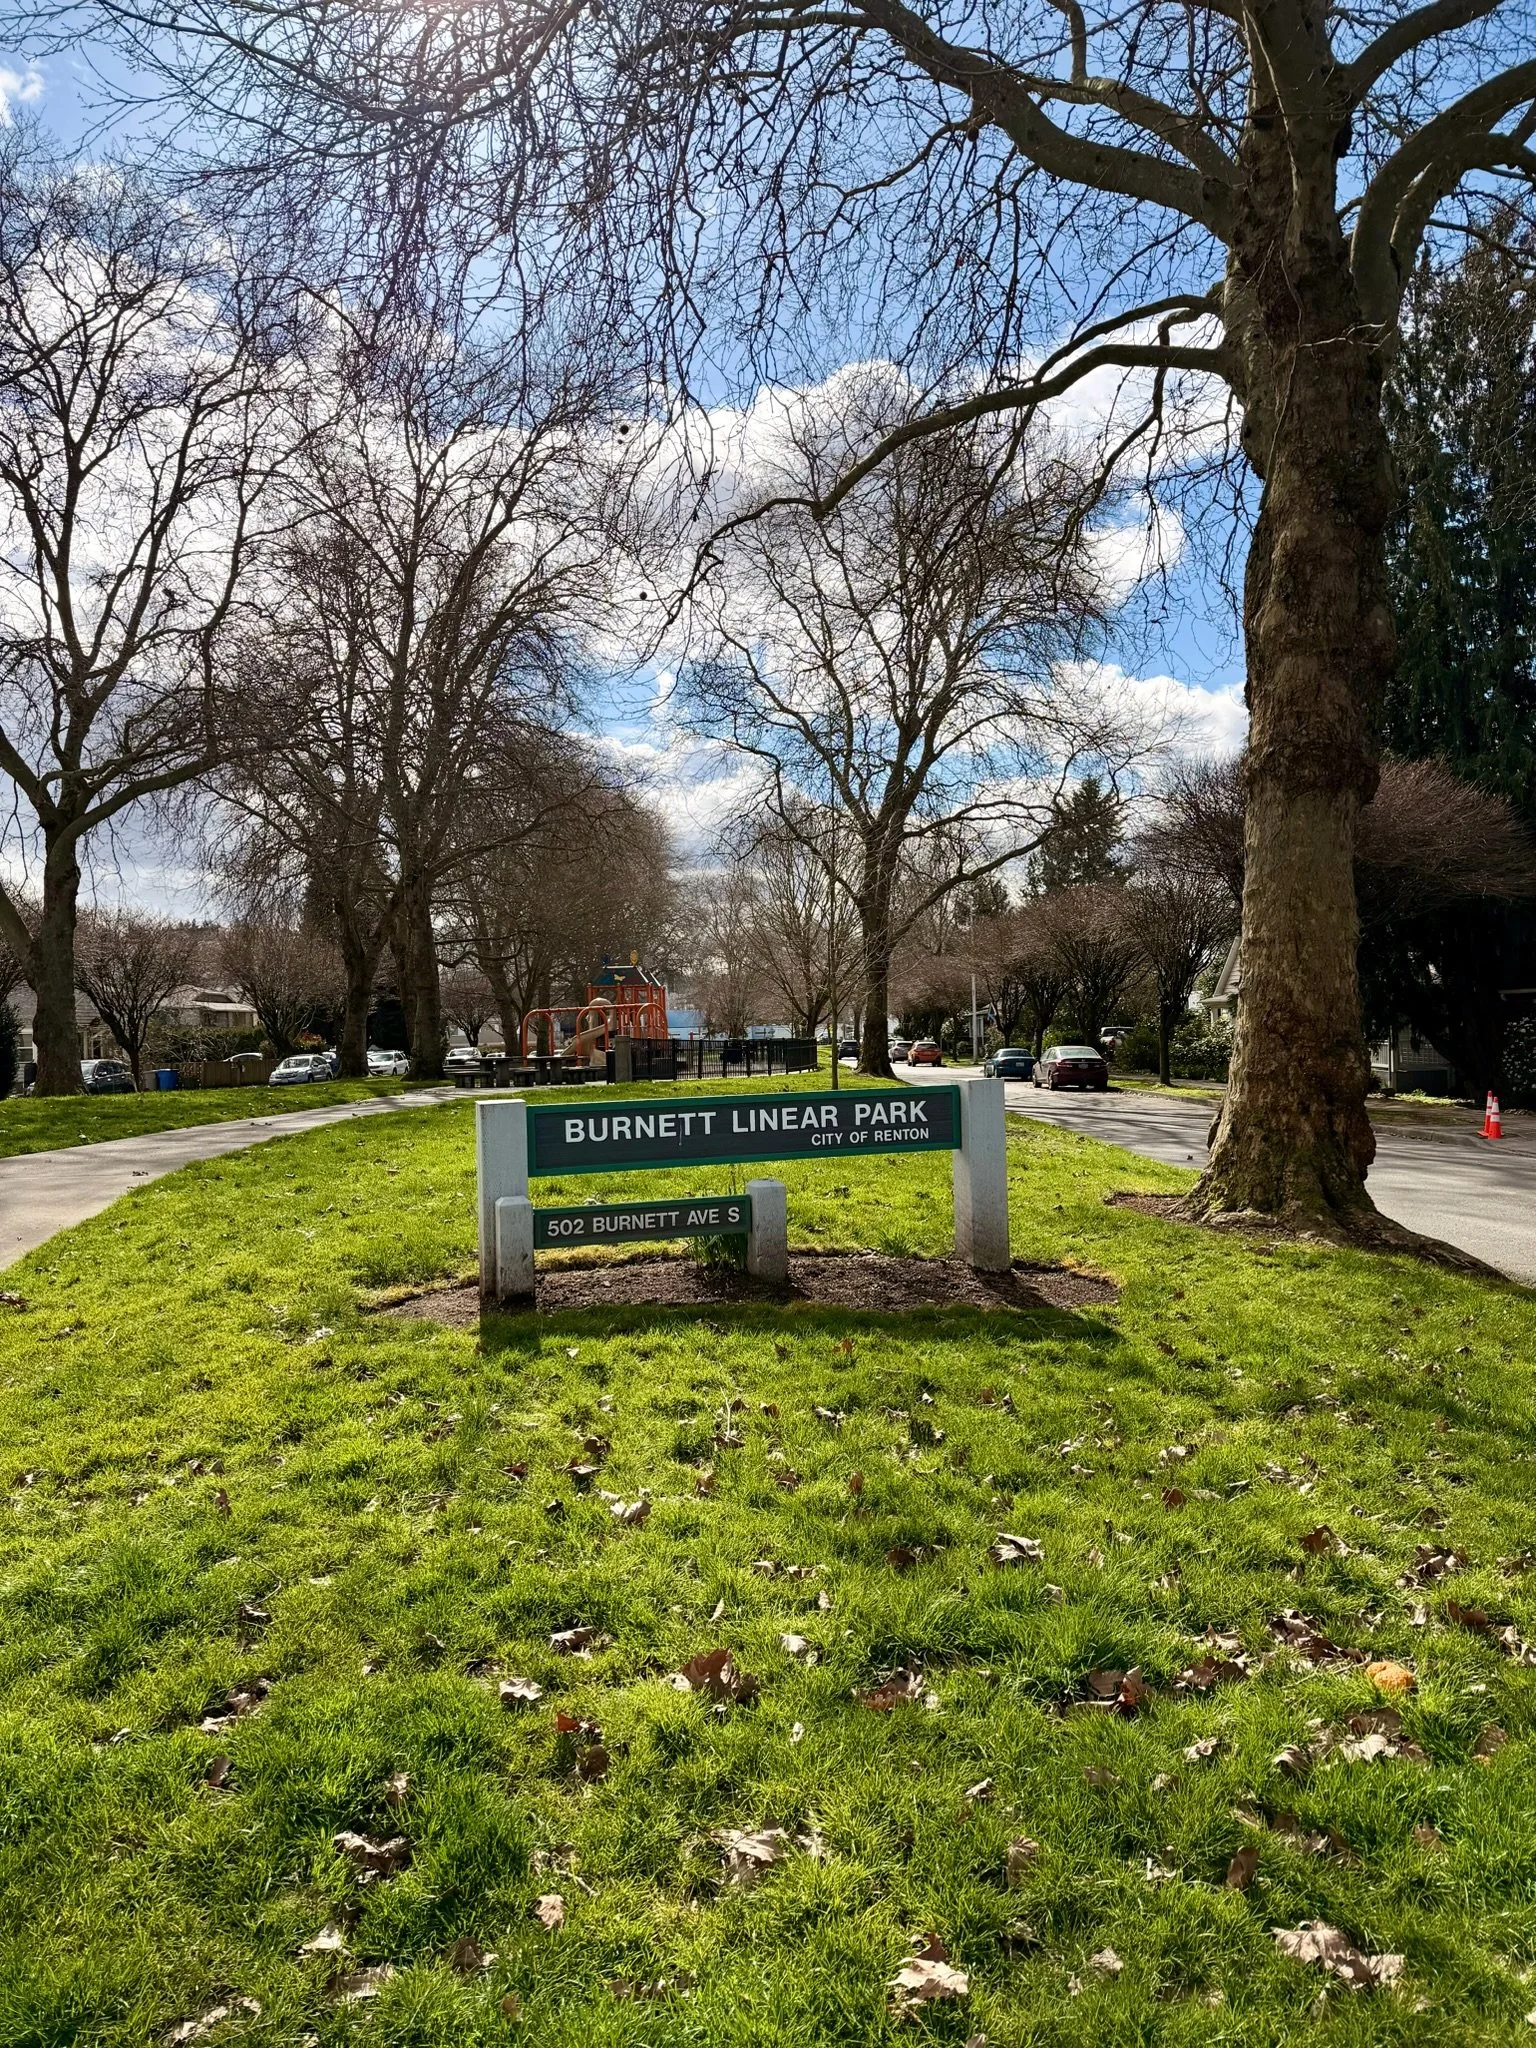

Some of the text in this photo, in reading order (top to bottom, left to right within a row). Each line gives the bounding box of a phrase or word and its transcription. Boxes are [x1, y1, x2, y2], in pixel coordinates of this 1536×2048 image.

[565, 1101, 929, 1142] BURNETT LINEAR PARK
[811, 1128, 930, 1146] CITY OF RENTON
[547, 1207, 740, 1237] 502 BURNETT AVE S
